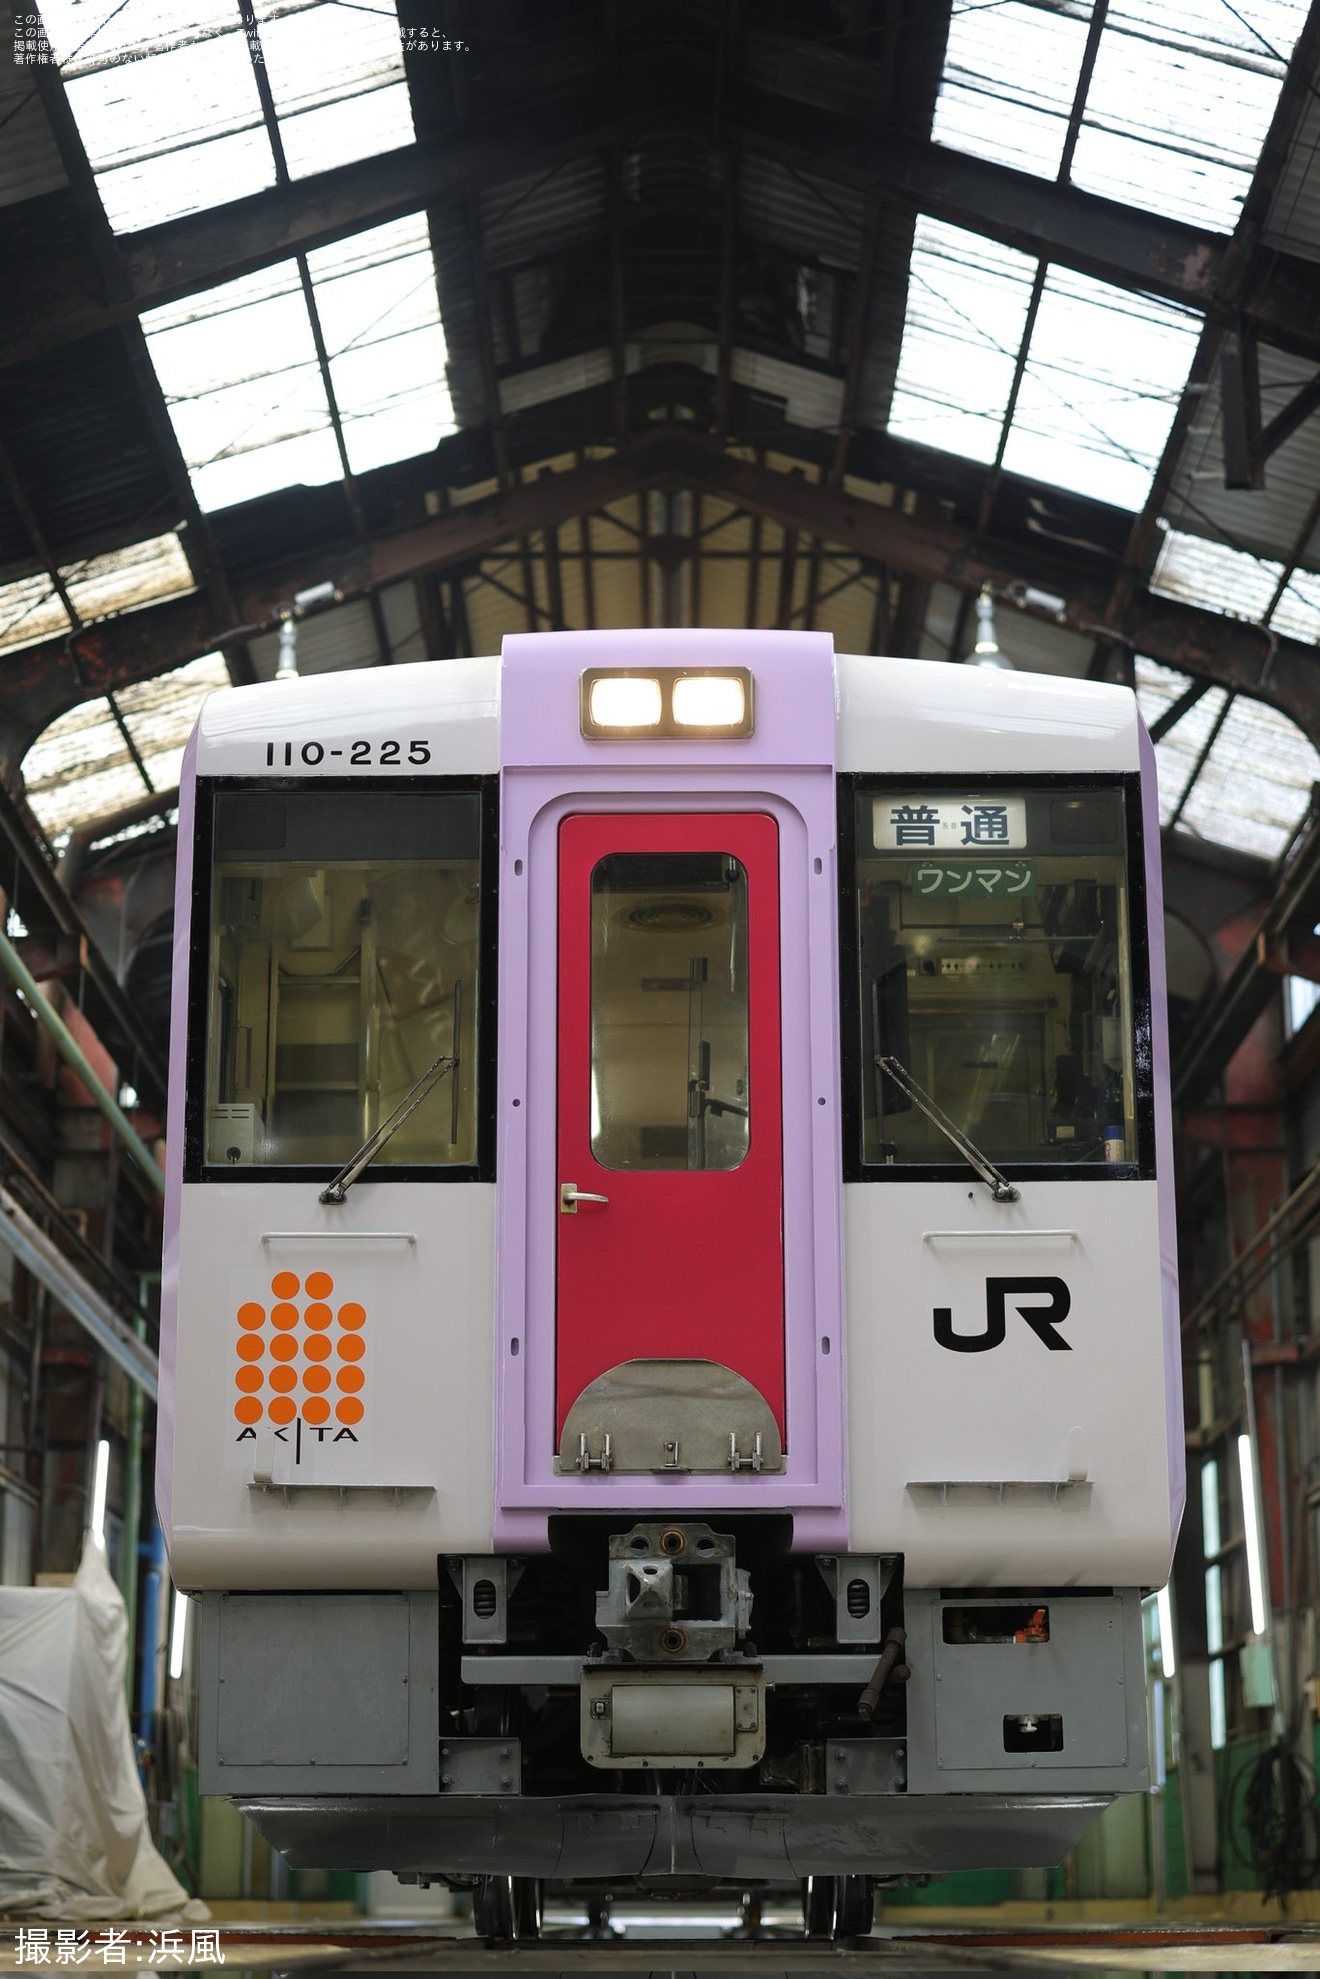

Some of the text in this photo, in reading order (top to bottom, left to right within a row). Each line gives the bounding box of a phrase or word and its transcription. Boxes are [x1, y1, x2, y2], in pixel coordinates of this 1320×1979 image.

[266, 740, 432, 766] 110-225
[890, 805, 1010, 846] 普通
[917, 869, 1031, 893] ワンマン
[933, 1276, 1073, 1353] JR
